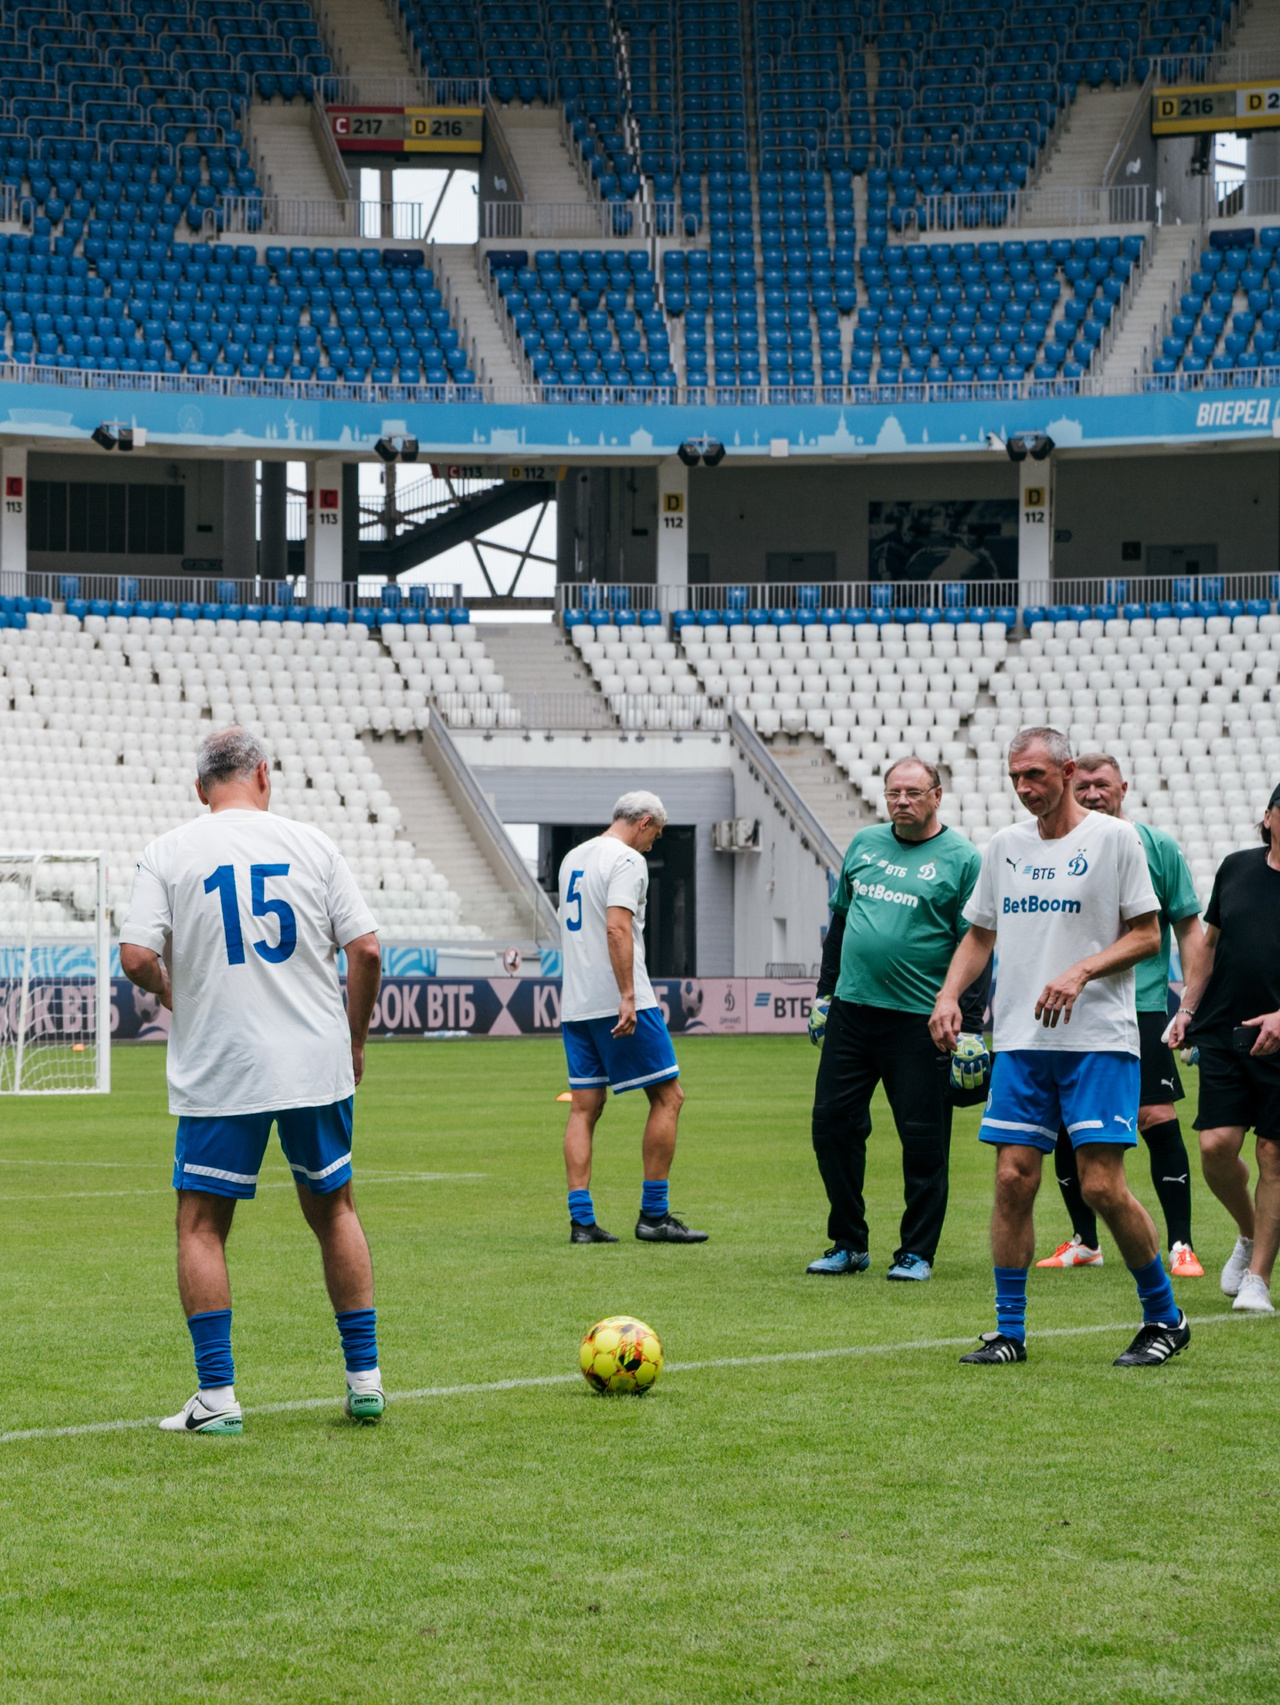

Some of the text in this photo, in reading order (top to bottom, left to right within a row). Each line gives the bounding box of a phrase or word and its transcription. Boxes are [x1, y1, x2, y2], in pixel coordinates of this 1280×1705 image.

[1162, 101, 1174, 115] D
[1180, 98, 1213, 115] 216
[1249, 94, 1262, 110] D
[335, 118, 348, 134] C
[352, 119, 383, 135] 217
[415, 120, 462, 136] D 216
[1196, 398, 1271, 427] ВПЕРЕД
[462, 466, 483, 478] 113
[524, 467, 545, 479] 112
[667, 495, 680, 511] D
[1028, 489, 1041, 506] D
[6, 501, 23, 513] 113
[320, 513, 338, 525] 113
[664, 516, 684, 528] 112
[1024, 512, 1045, 523] 112
[884, 864, 908, 878] ВТБ
[1031, 867, 1056, 880] ВТБ
[566, 870, 584, 931] 5
[852, 879, 919, 908] BetBoom
[1002, 895, 1082, 914] BetBoom
[203, 863, 298, 966] 15
[371, 984, 476, 1029] БОК ВТБ
[774, 997, 812, 1018] ВТБ
